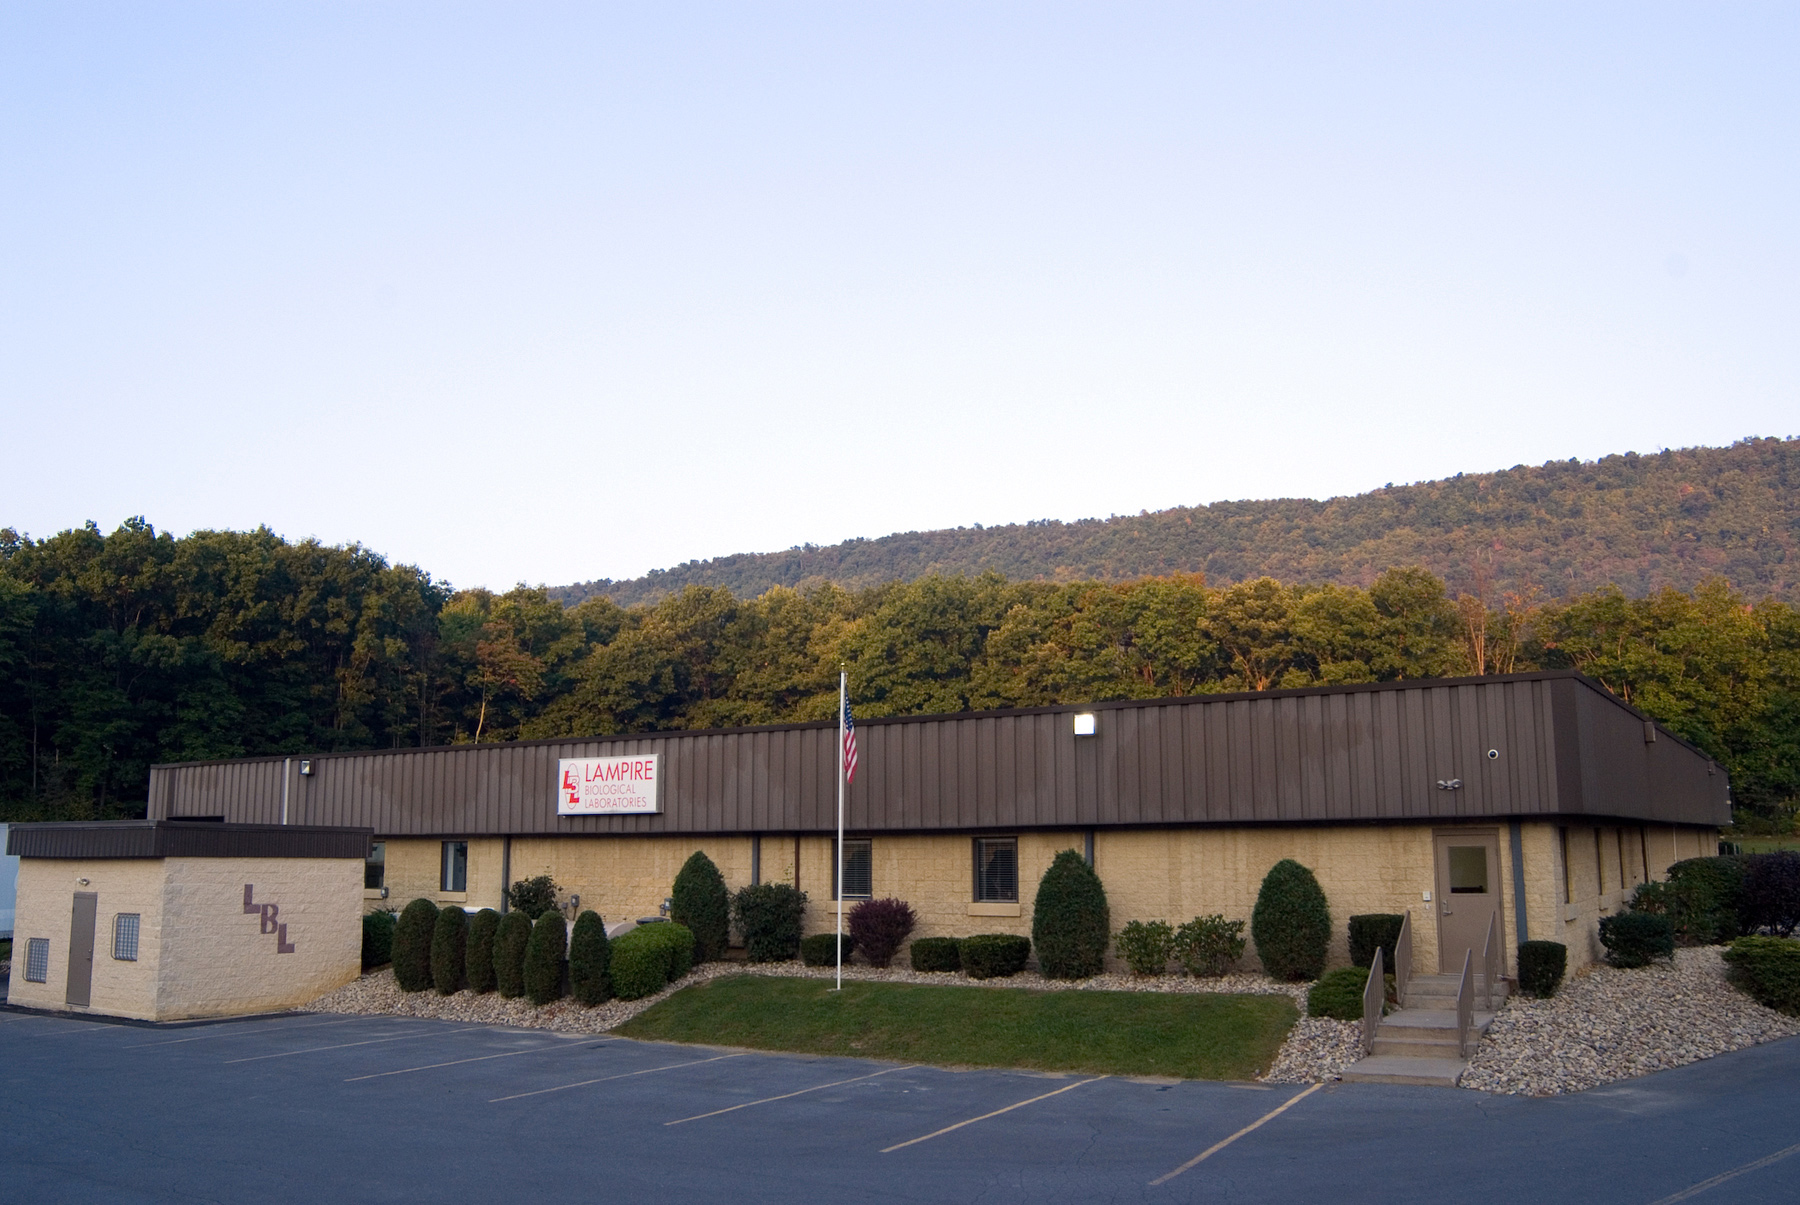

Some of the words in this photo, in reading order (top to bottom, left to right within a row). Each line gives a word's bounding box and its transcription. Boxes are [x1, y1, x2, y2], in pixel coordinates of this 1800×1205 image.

[585, 761, 653, 782] LAMPIRE
[585, 784, 636, 795] BIOLOGICAL
[585, 796, 647, 808] LABORATORIES
